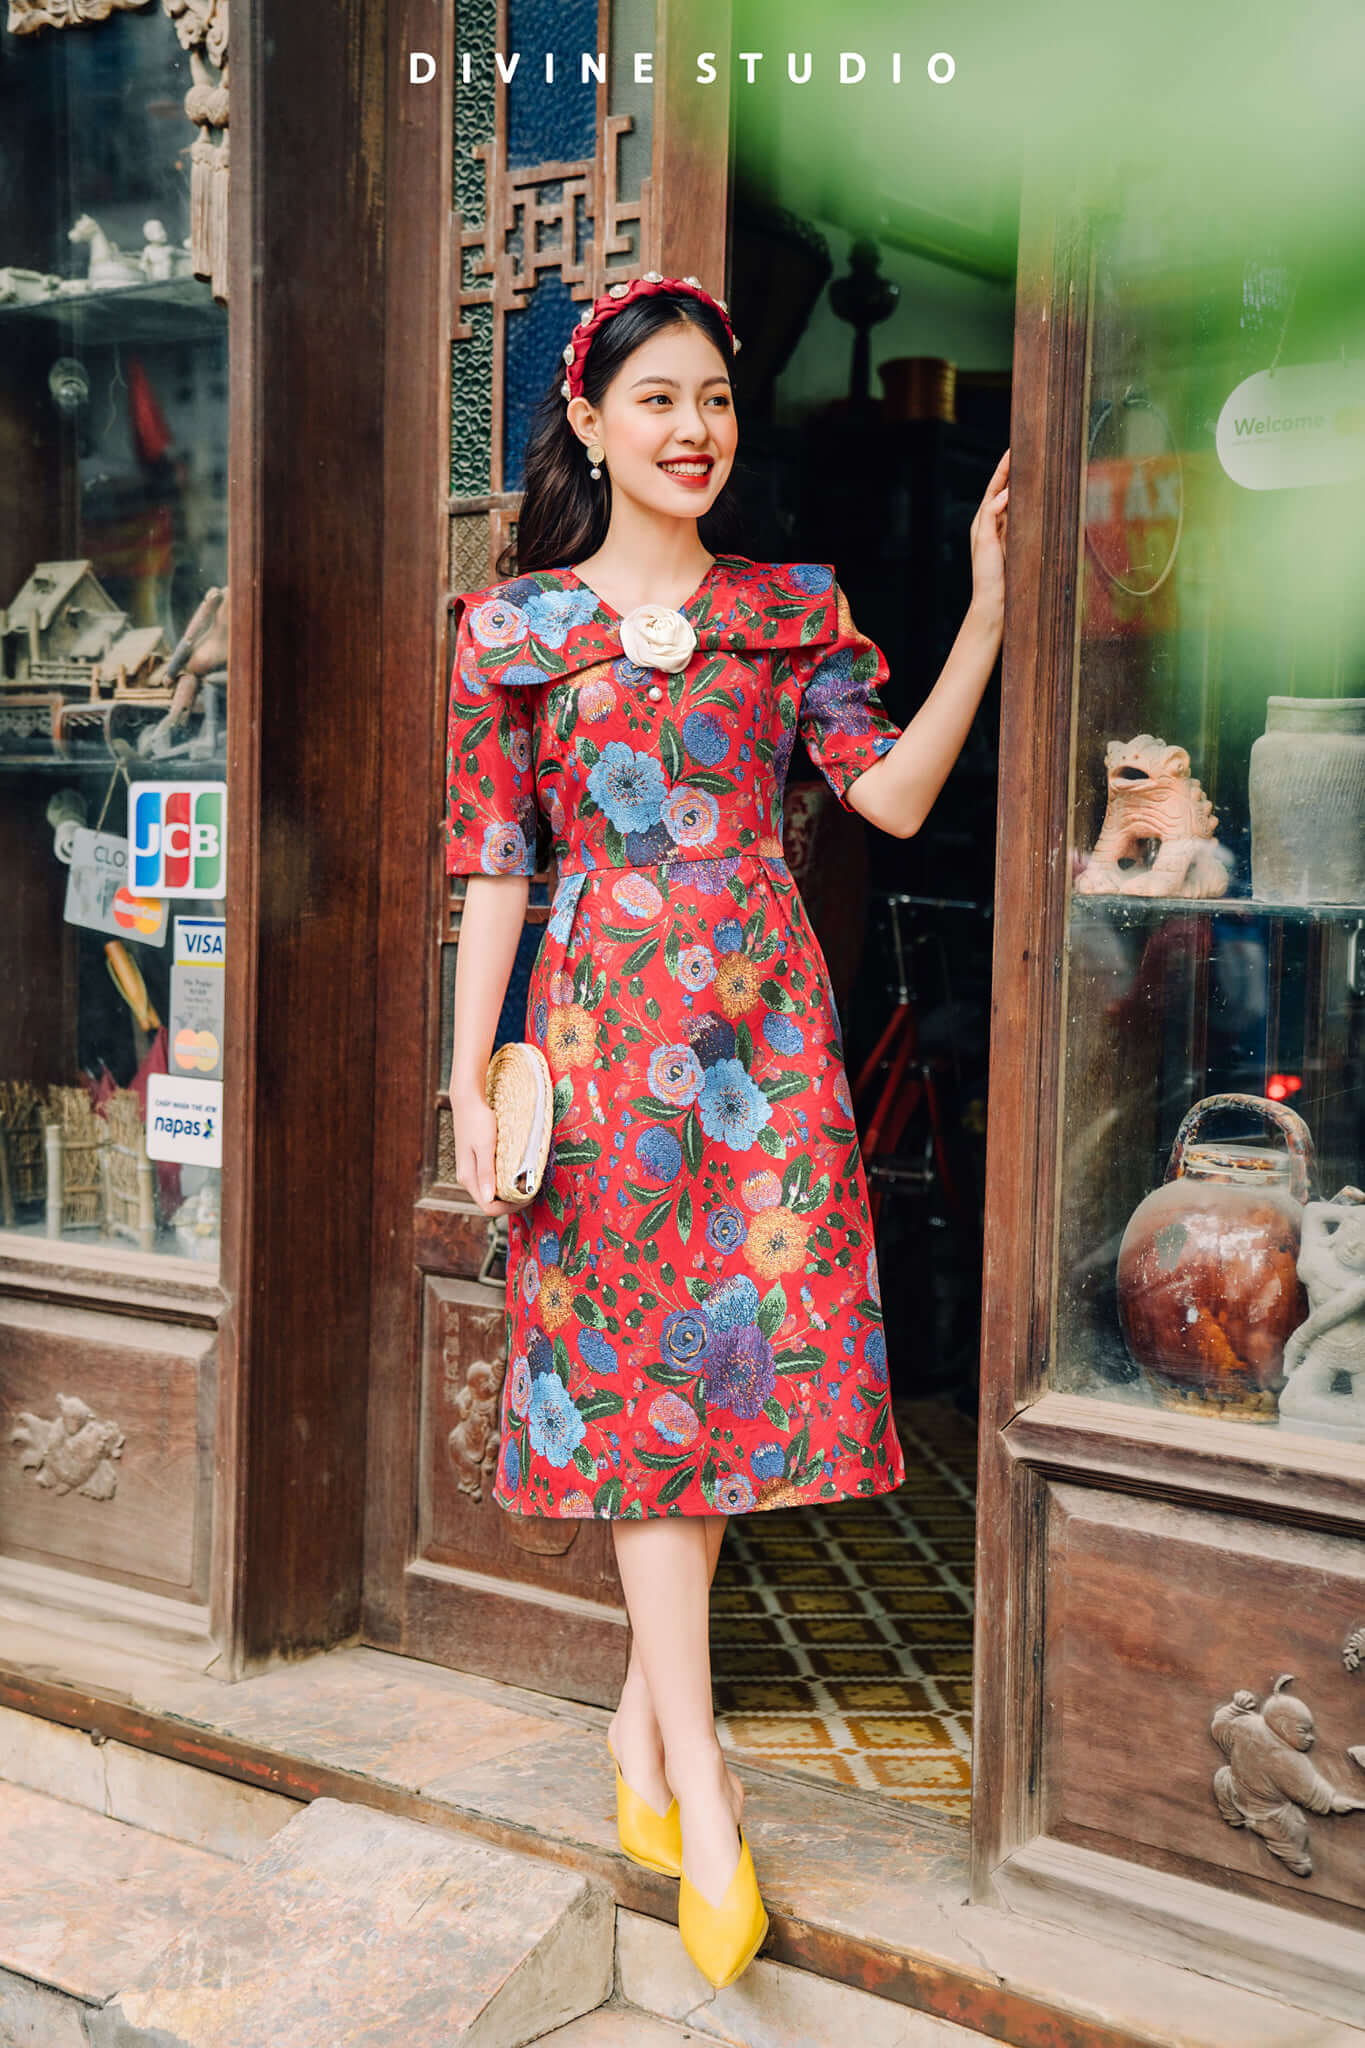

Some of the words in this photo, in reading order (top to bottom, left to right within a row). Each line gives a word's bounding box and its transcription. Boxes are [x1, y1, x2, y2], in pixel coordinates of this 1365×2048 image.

[1234, 415, 1325, 437] Welcome
[136, 823, 219, 857] JCB
[184, 933, 223, 954] VISA
[154, 1116, 201, 1138] napas
